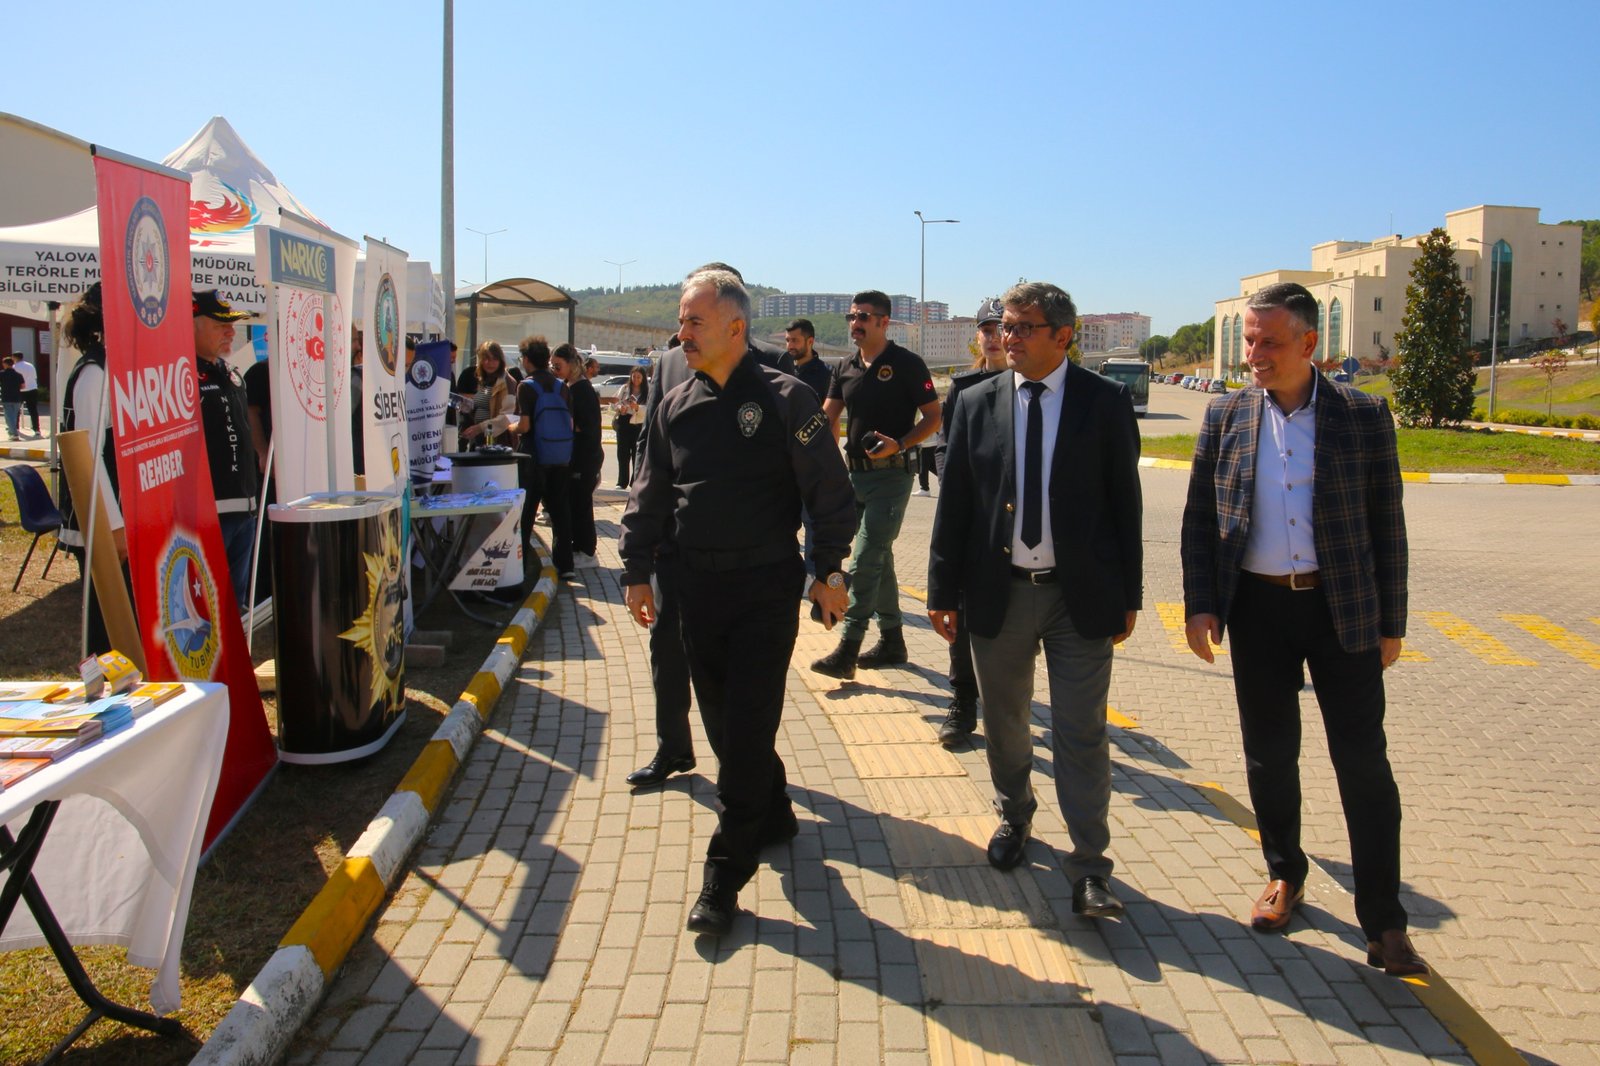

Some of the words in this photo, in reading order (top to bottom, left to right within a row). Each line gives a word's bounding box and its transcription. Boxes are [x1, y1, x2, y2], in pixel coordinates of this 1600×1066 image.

[35, 251, 97, 262] YALOVA
[5, 264, 79, 278] TERÖRLE
[113, 356, 195, 437] NARKO
[138, 449, 185, 492] REHBER
